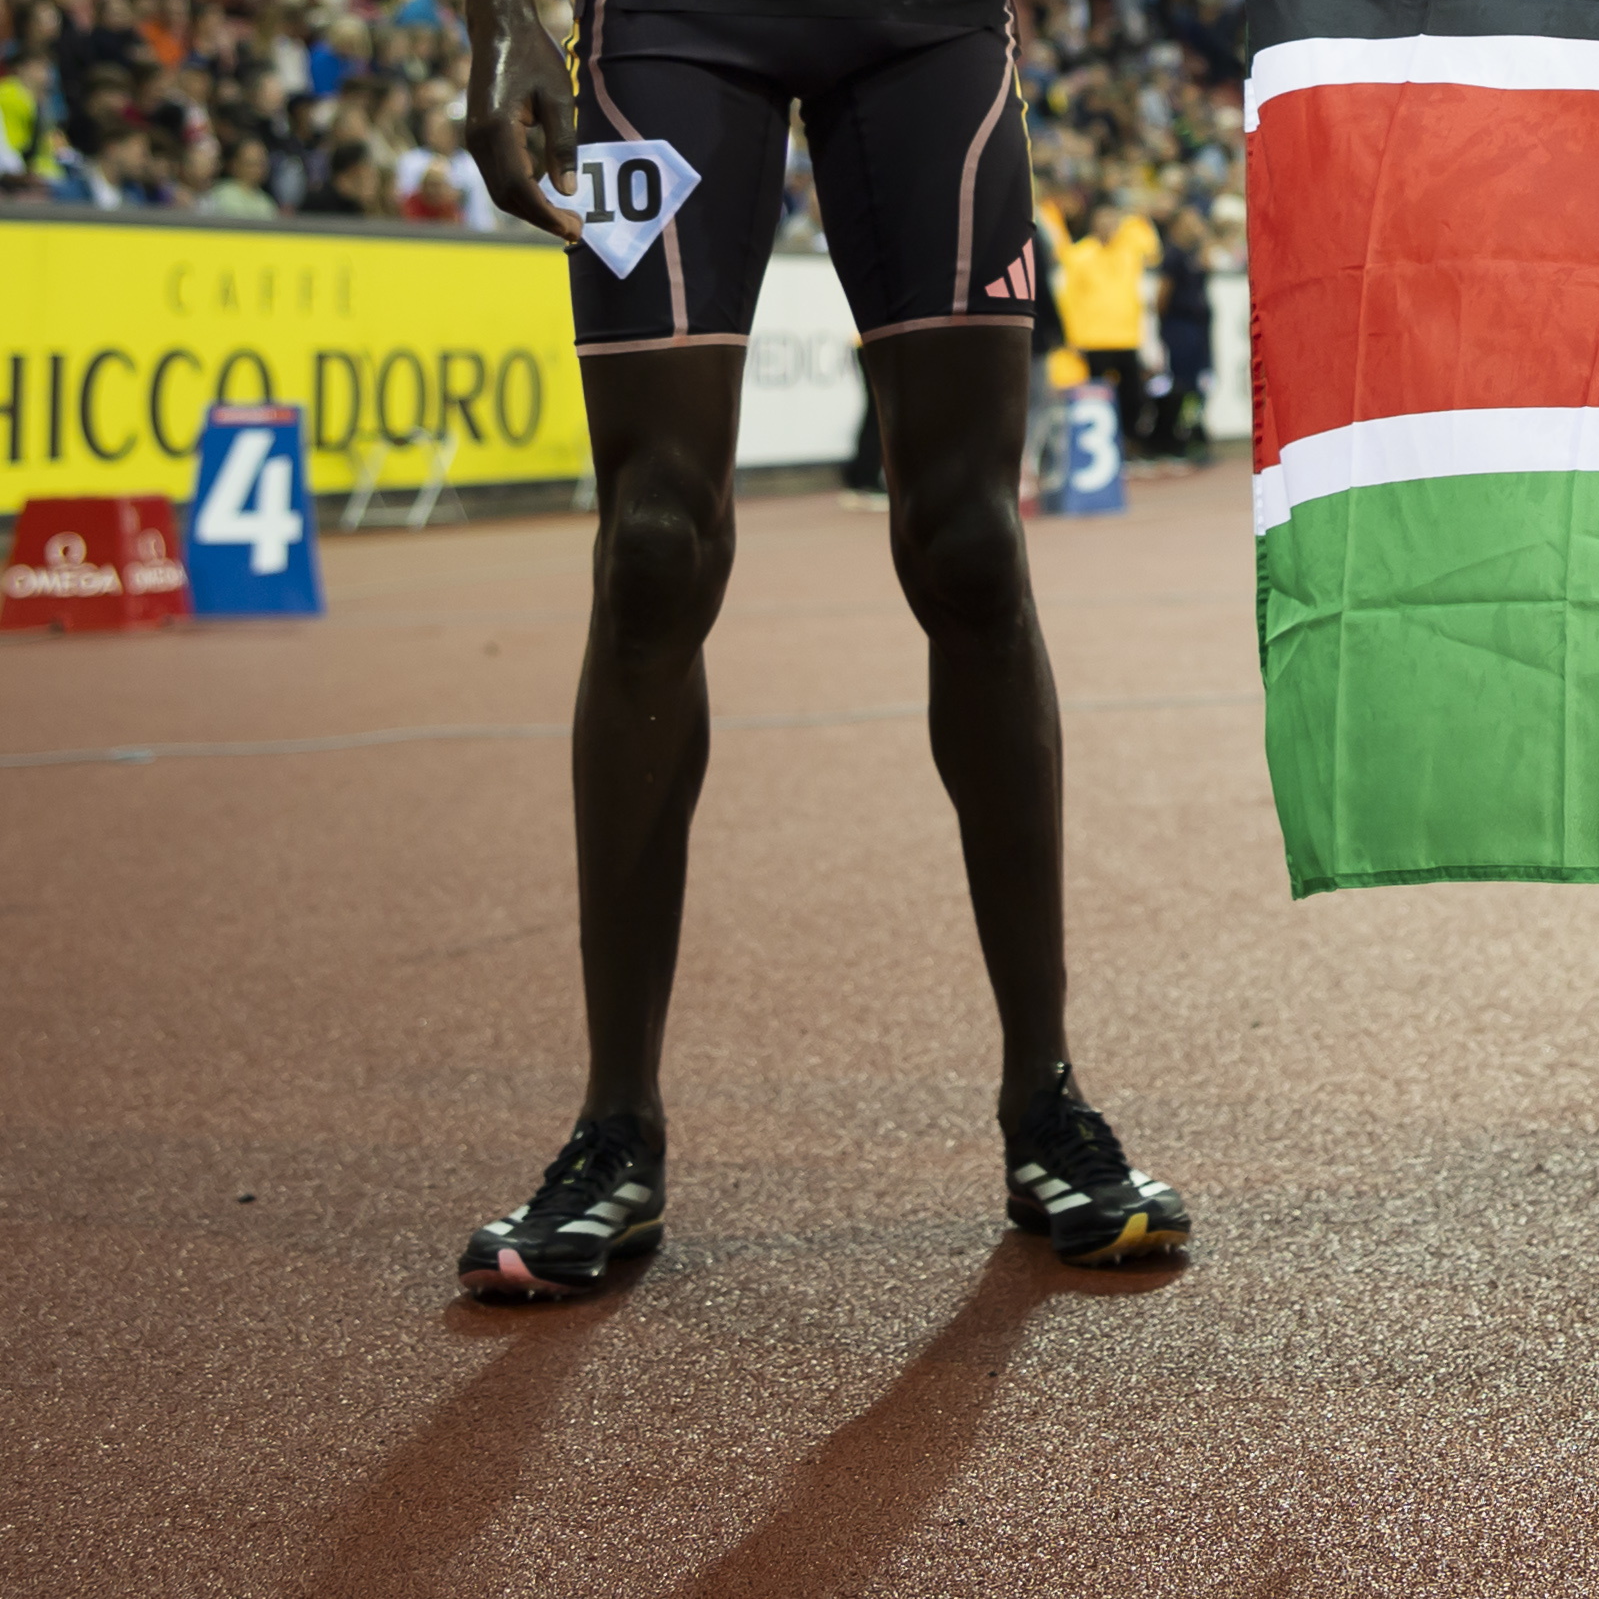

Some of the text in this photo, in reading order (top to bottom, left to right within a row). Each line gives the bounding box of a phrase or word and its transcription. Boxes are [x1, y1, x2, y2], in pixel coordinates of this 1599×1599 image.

[582, 157, 662, 223] 10
[1072, 399, 1119, 494] 3
[196, 428, 302, 576] 4
